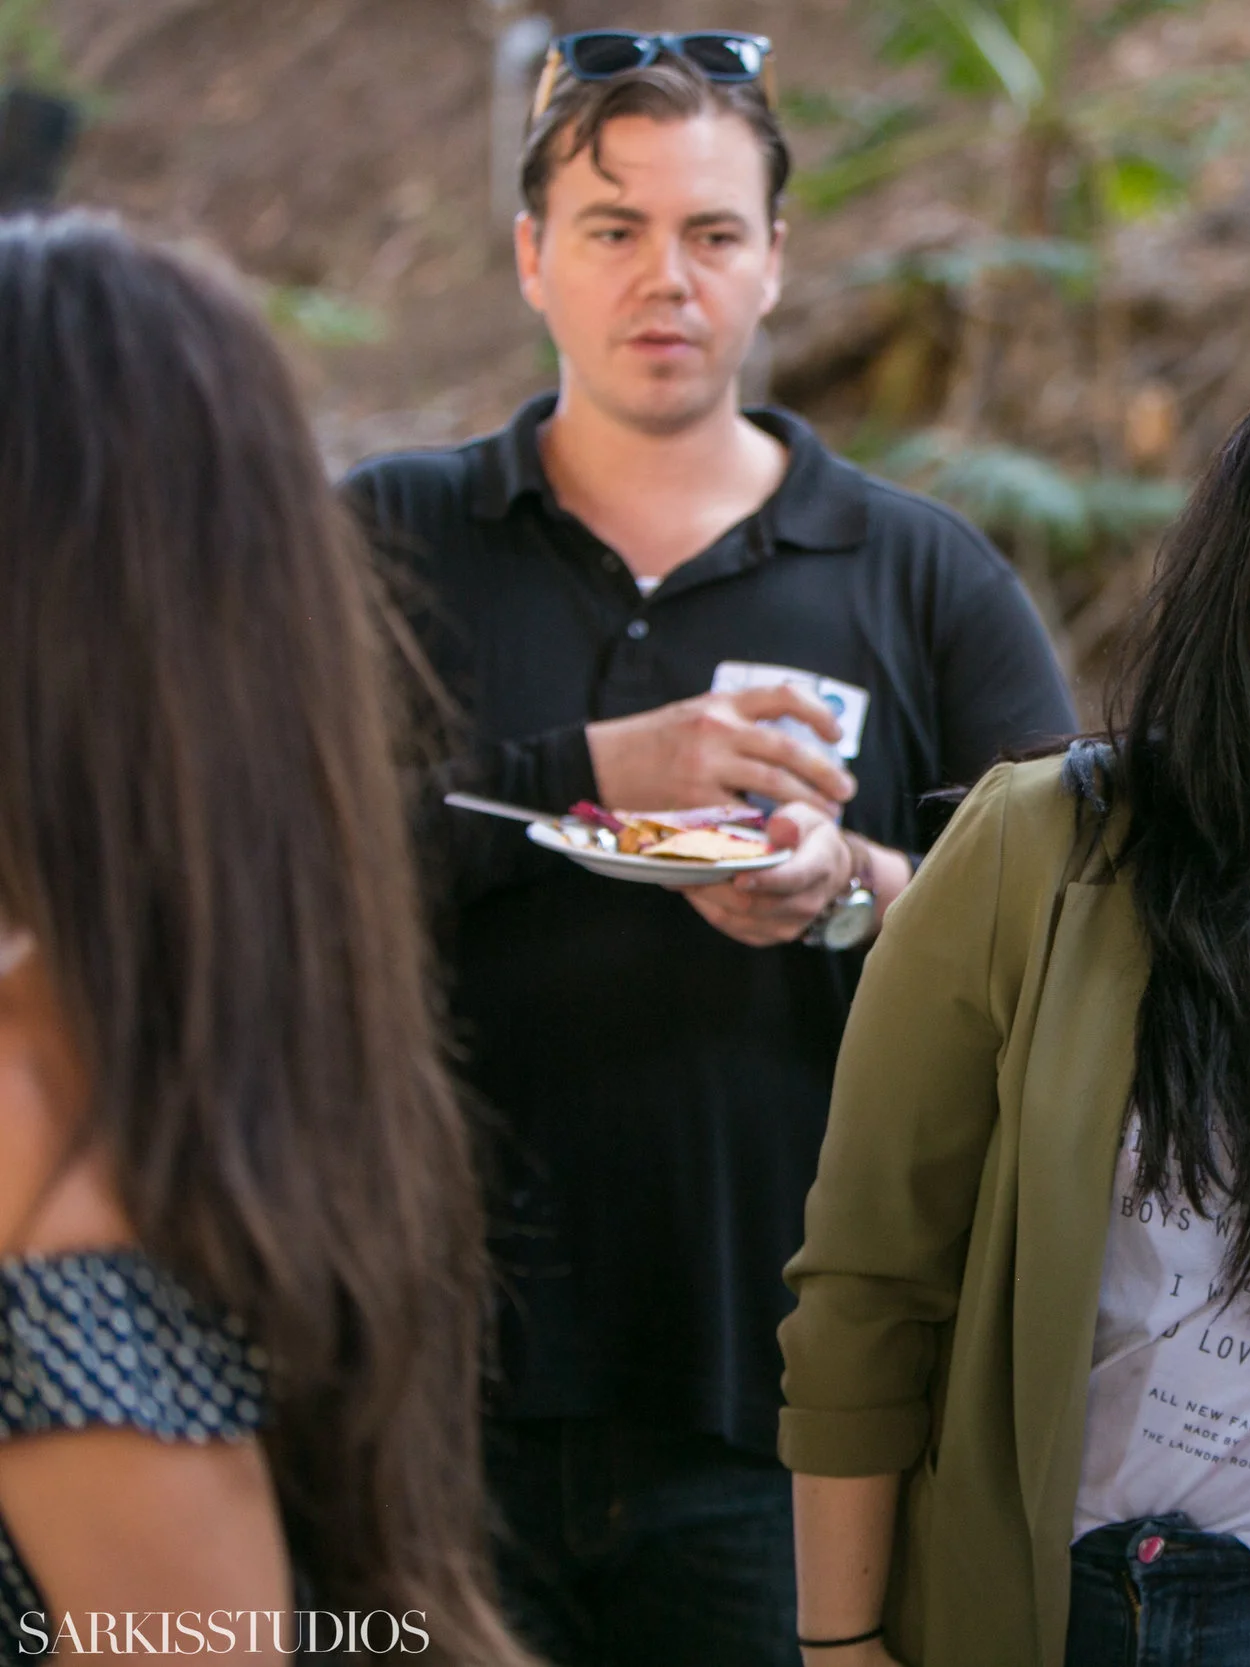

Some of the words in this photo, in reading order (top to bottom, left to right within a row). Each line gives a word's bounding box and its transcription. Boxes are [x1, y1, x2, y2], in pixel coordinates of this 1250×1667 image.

[1120, 1195, 1192, 1231] BOYS
[1149, 1387, 1178, 1407] ALL
[1185, 1401, 1224, 1421] NEW
[1142, 1428, 1165, 1444] THE
[1168, 1439, 1225, 1464] LAUNDR
[1183, 1423, 1219, 1442] MADE
[1223, 1437, 1241, 1448] BY
